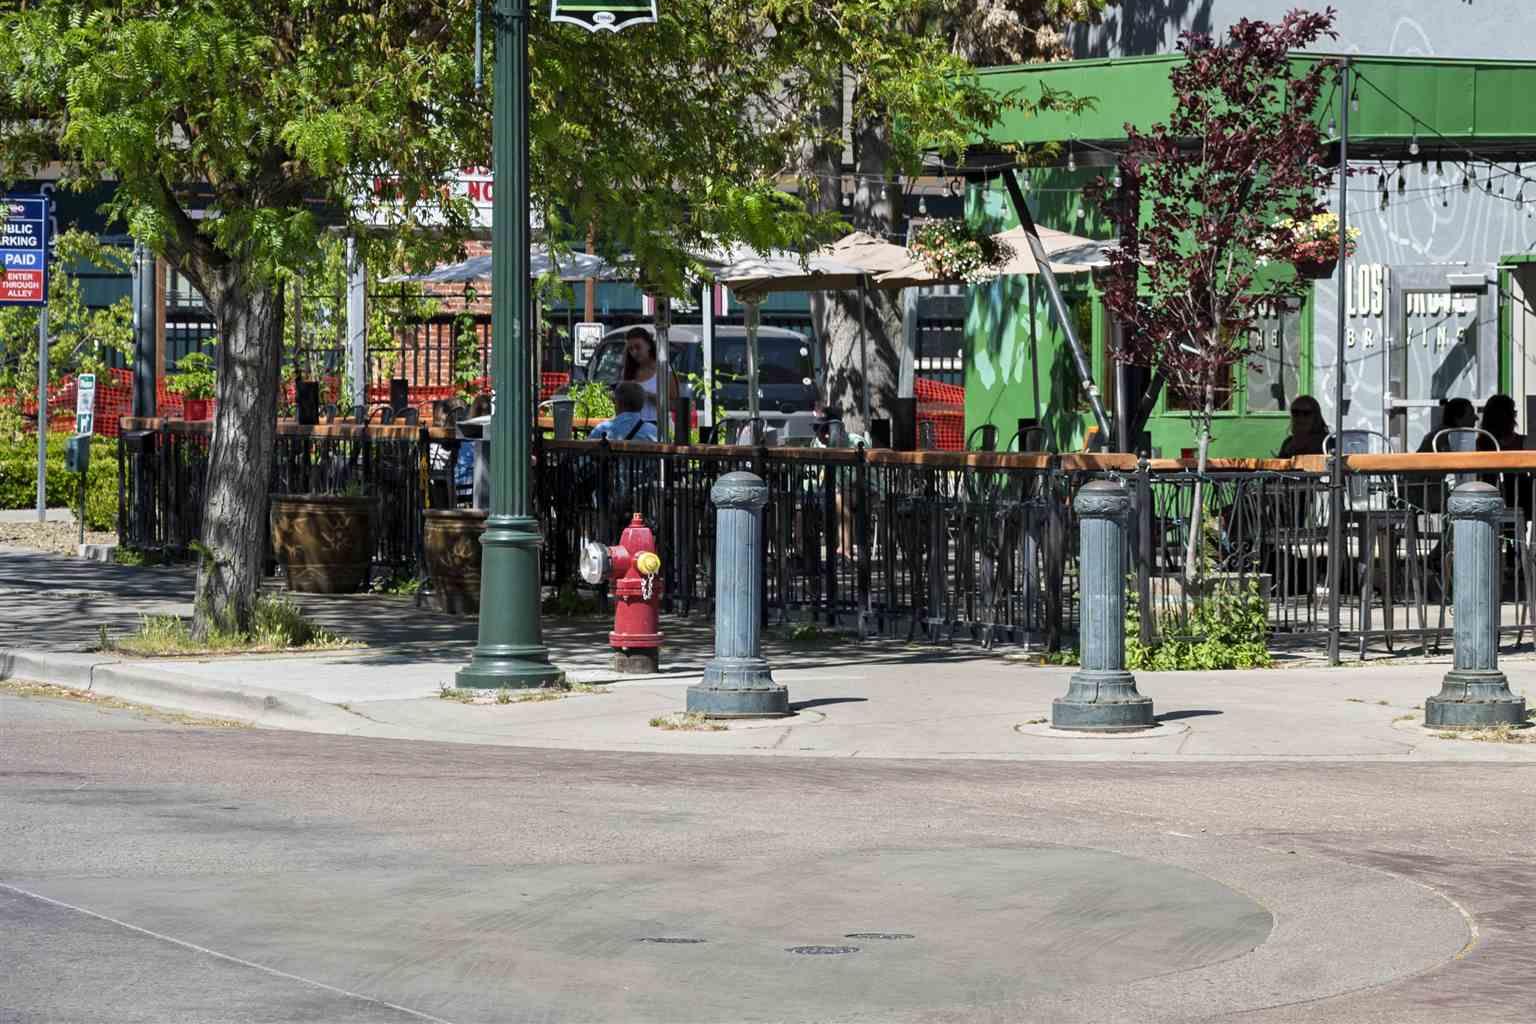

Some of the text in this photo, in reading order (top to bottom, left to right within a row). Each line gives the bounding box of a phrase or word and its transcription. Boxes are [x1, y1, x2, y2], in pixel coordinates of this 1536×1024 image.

[5, 253, 36, 265] PAID
[7, 272, 33, 281] ENTER
[2, 281, 39, 289] THROUGH
[7, 289, 33, 297] ALLEY
